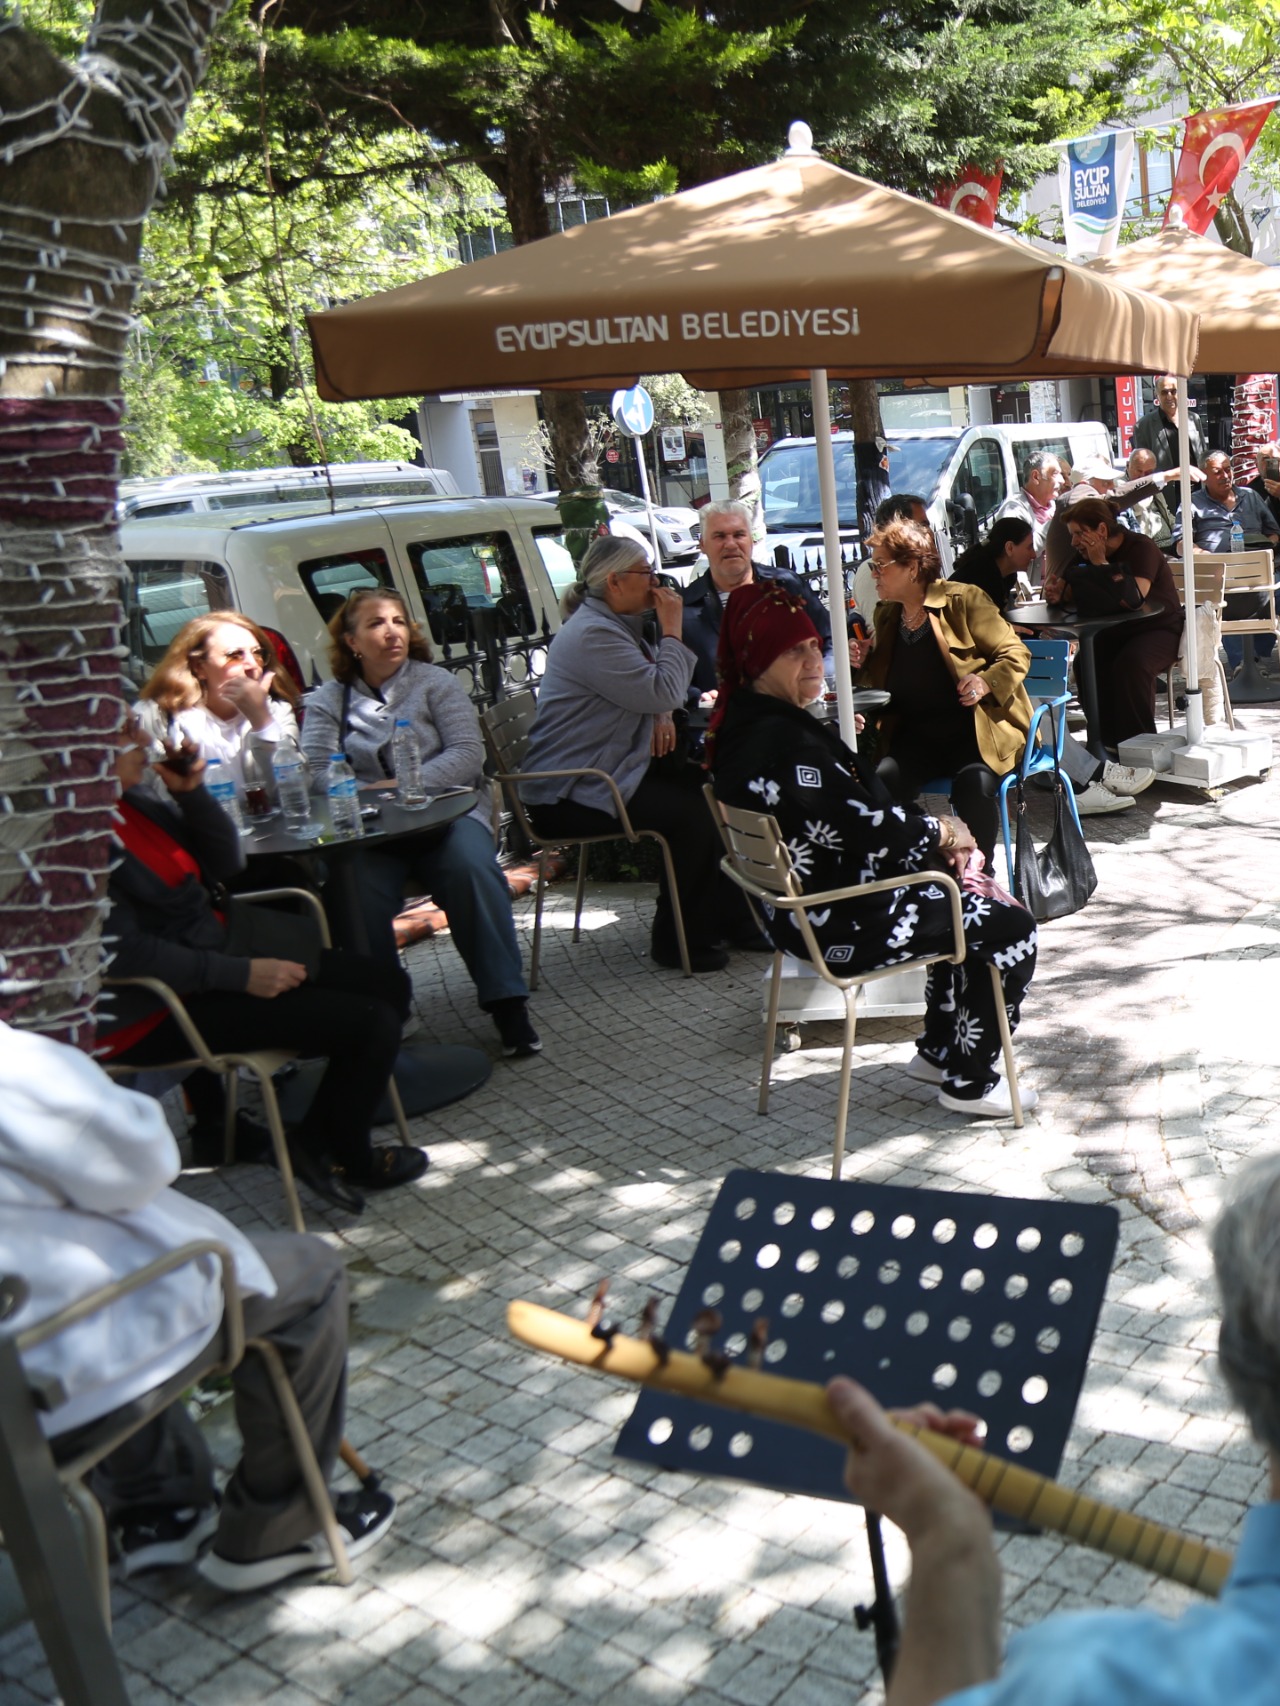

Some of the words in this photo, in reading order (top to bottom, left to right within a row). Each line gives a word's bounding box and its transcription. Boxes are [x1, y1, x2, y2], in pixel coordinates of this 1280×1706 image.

[1074, 165, 1110, 188] EYÜP
[1074, 183, 1110, 201] SULTAN
[496, 315, 669, 353] EYÜPSULTAN
